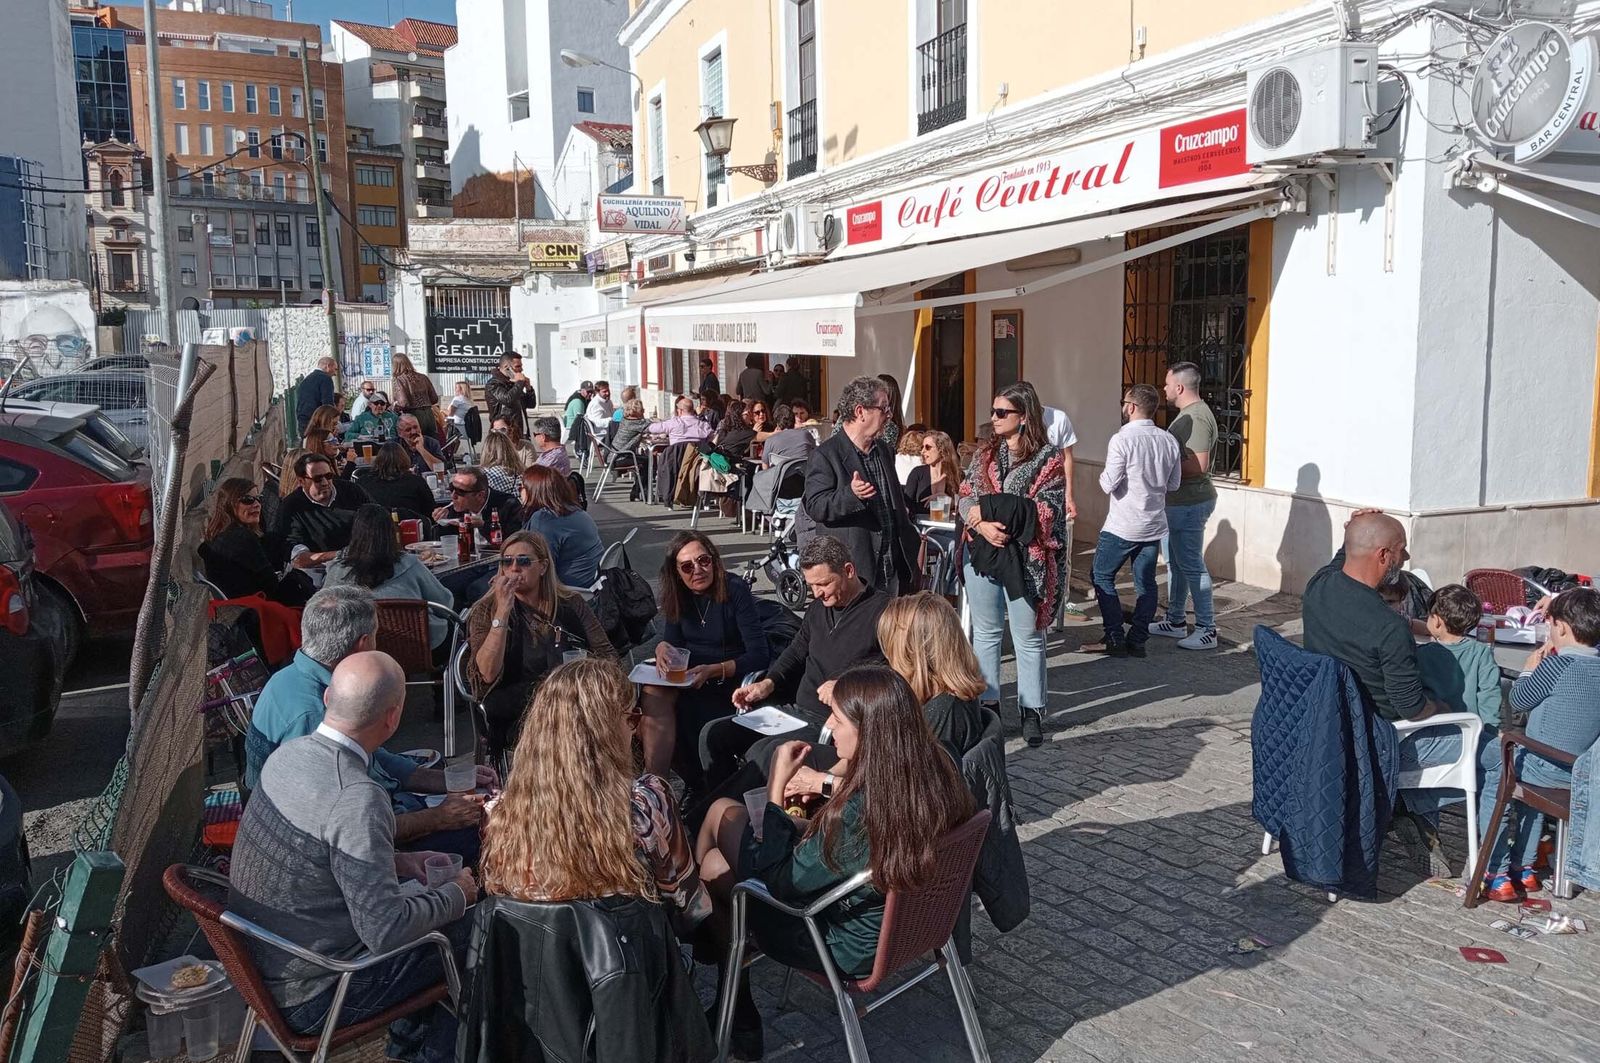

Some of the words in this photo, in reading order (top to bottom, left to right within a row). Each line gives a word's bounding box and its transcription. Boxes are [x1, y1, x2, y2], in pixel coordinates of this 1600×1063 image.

[1485, 39, 1560, 138] Cruzcampo
[1530, 129, 1552, 151] BAR
[1553, 66, 1584, 128] CENTRAL
[1174, 125, 1238, 153] Cruzcampo
[1173, 154, 1201, 165] MAESTROS
[1202, 146, 1241, 159] CERVECEROS
[1036, 159, 1051, 174] 1913
[897, 186, 964, 229] Café
[975, 141, 1135, 213] Central
[625, 207, 670, 217] AQUILINO
[634, 220, 662, 230] VIDAL
[545, 244, 578, 256] CNN
[692, 323, 698, 342] LA
[698, 323, 716, 342] CENTRAL
[736, 322, 743, 343] EN
[744, 322, 757, 343] 1913
[815, 322, 844, 336] Cruzcampo
[437, 344, 503, 356] GESTIA
